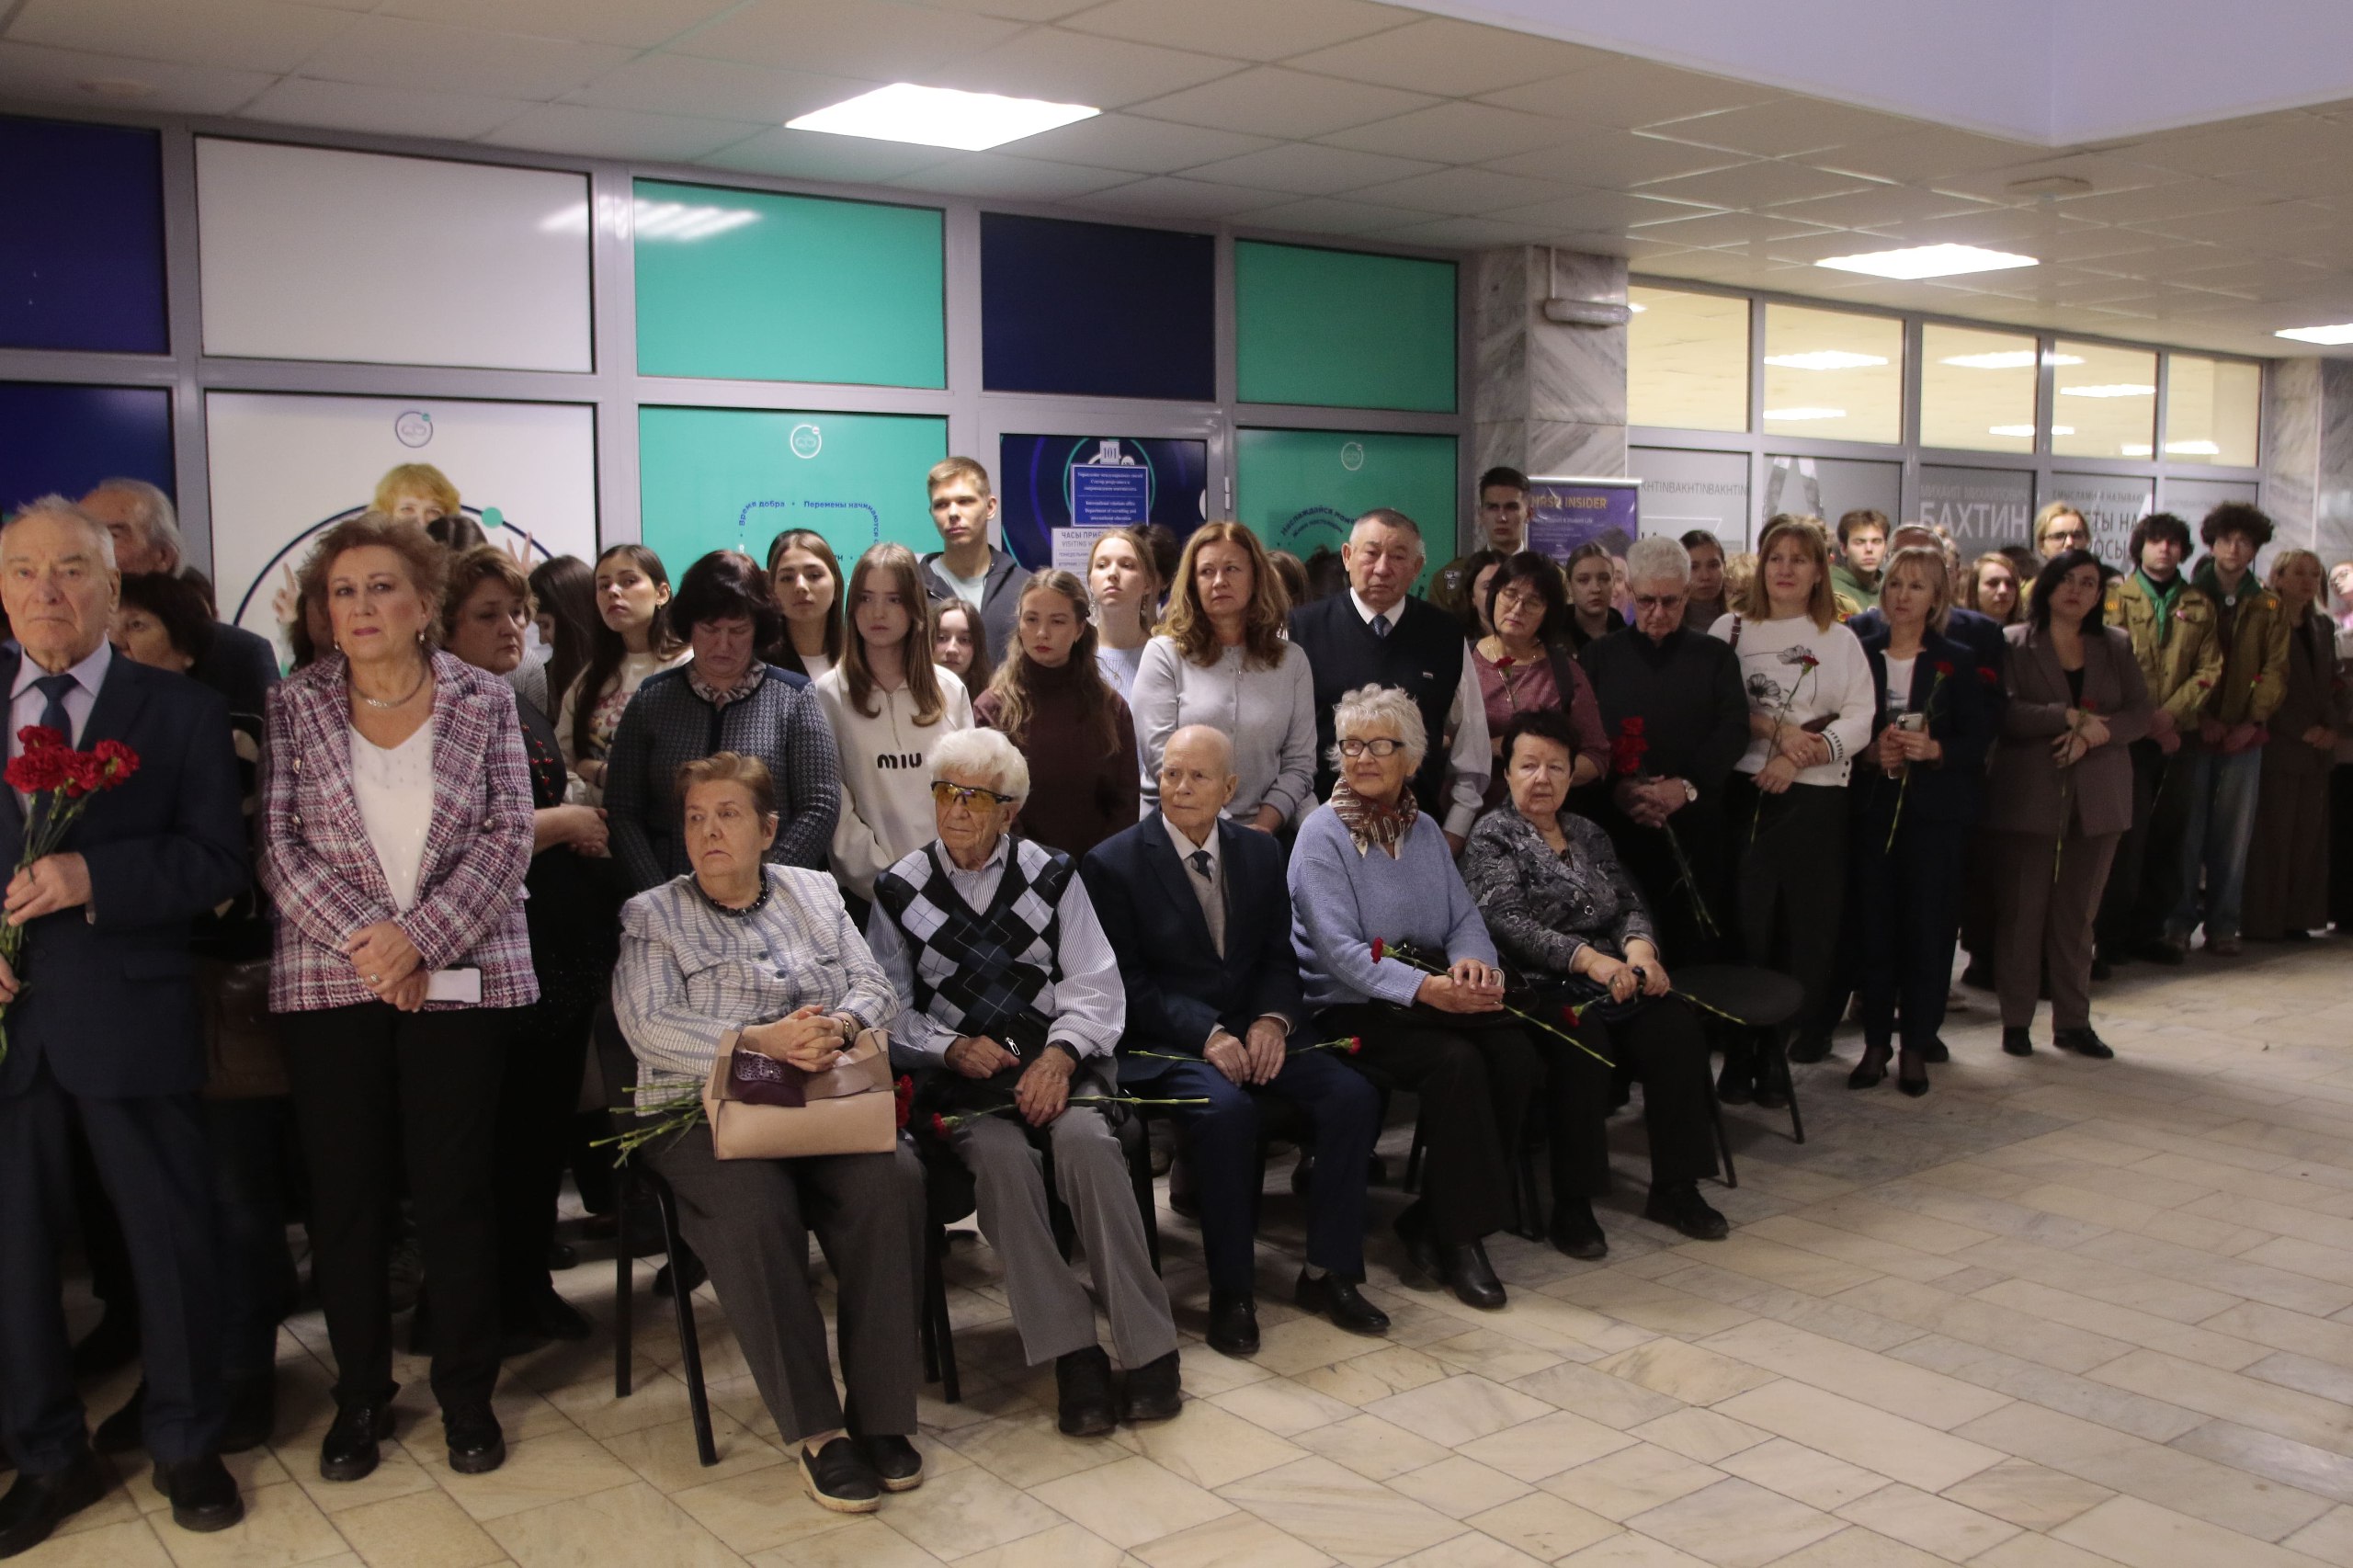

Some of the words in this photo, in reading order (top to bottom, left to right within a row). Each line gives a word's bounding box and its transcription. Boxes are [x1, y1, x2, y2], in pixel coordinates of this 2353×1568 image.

[1103, 448, 1117, 459] 101
[739, 501, 756, 526] Время
[1565, 497, 1607, 508] INSIDER
[848, 502, 880, 538] начинаются
[1919, 502, 2028, 540] БАХТИН
